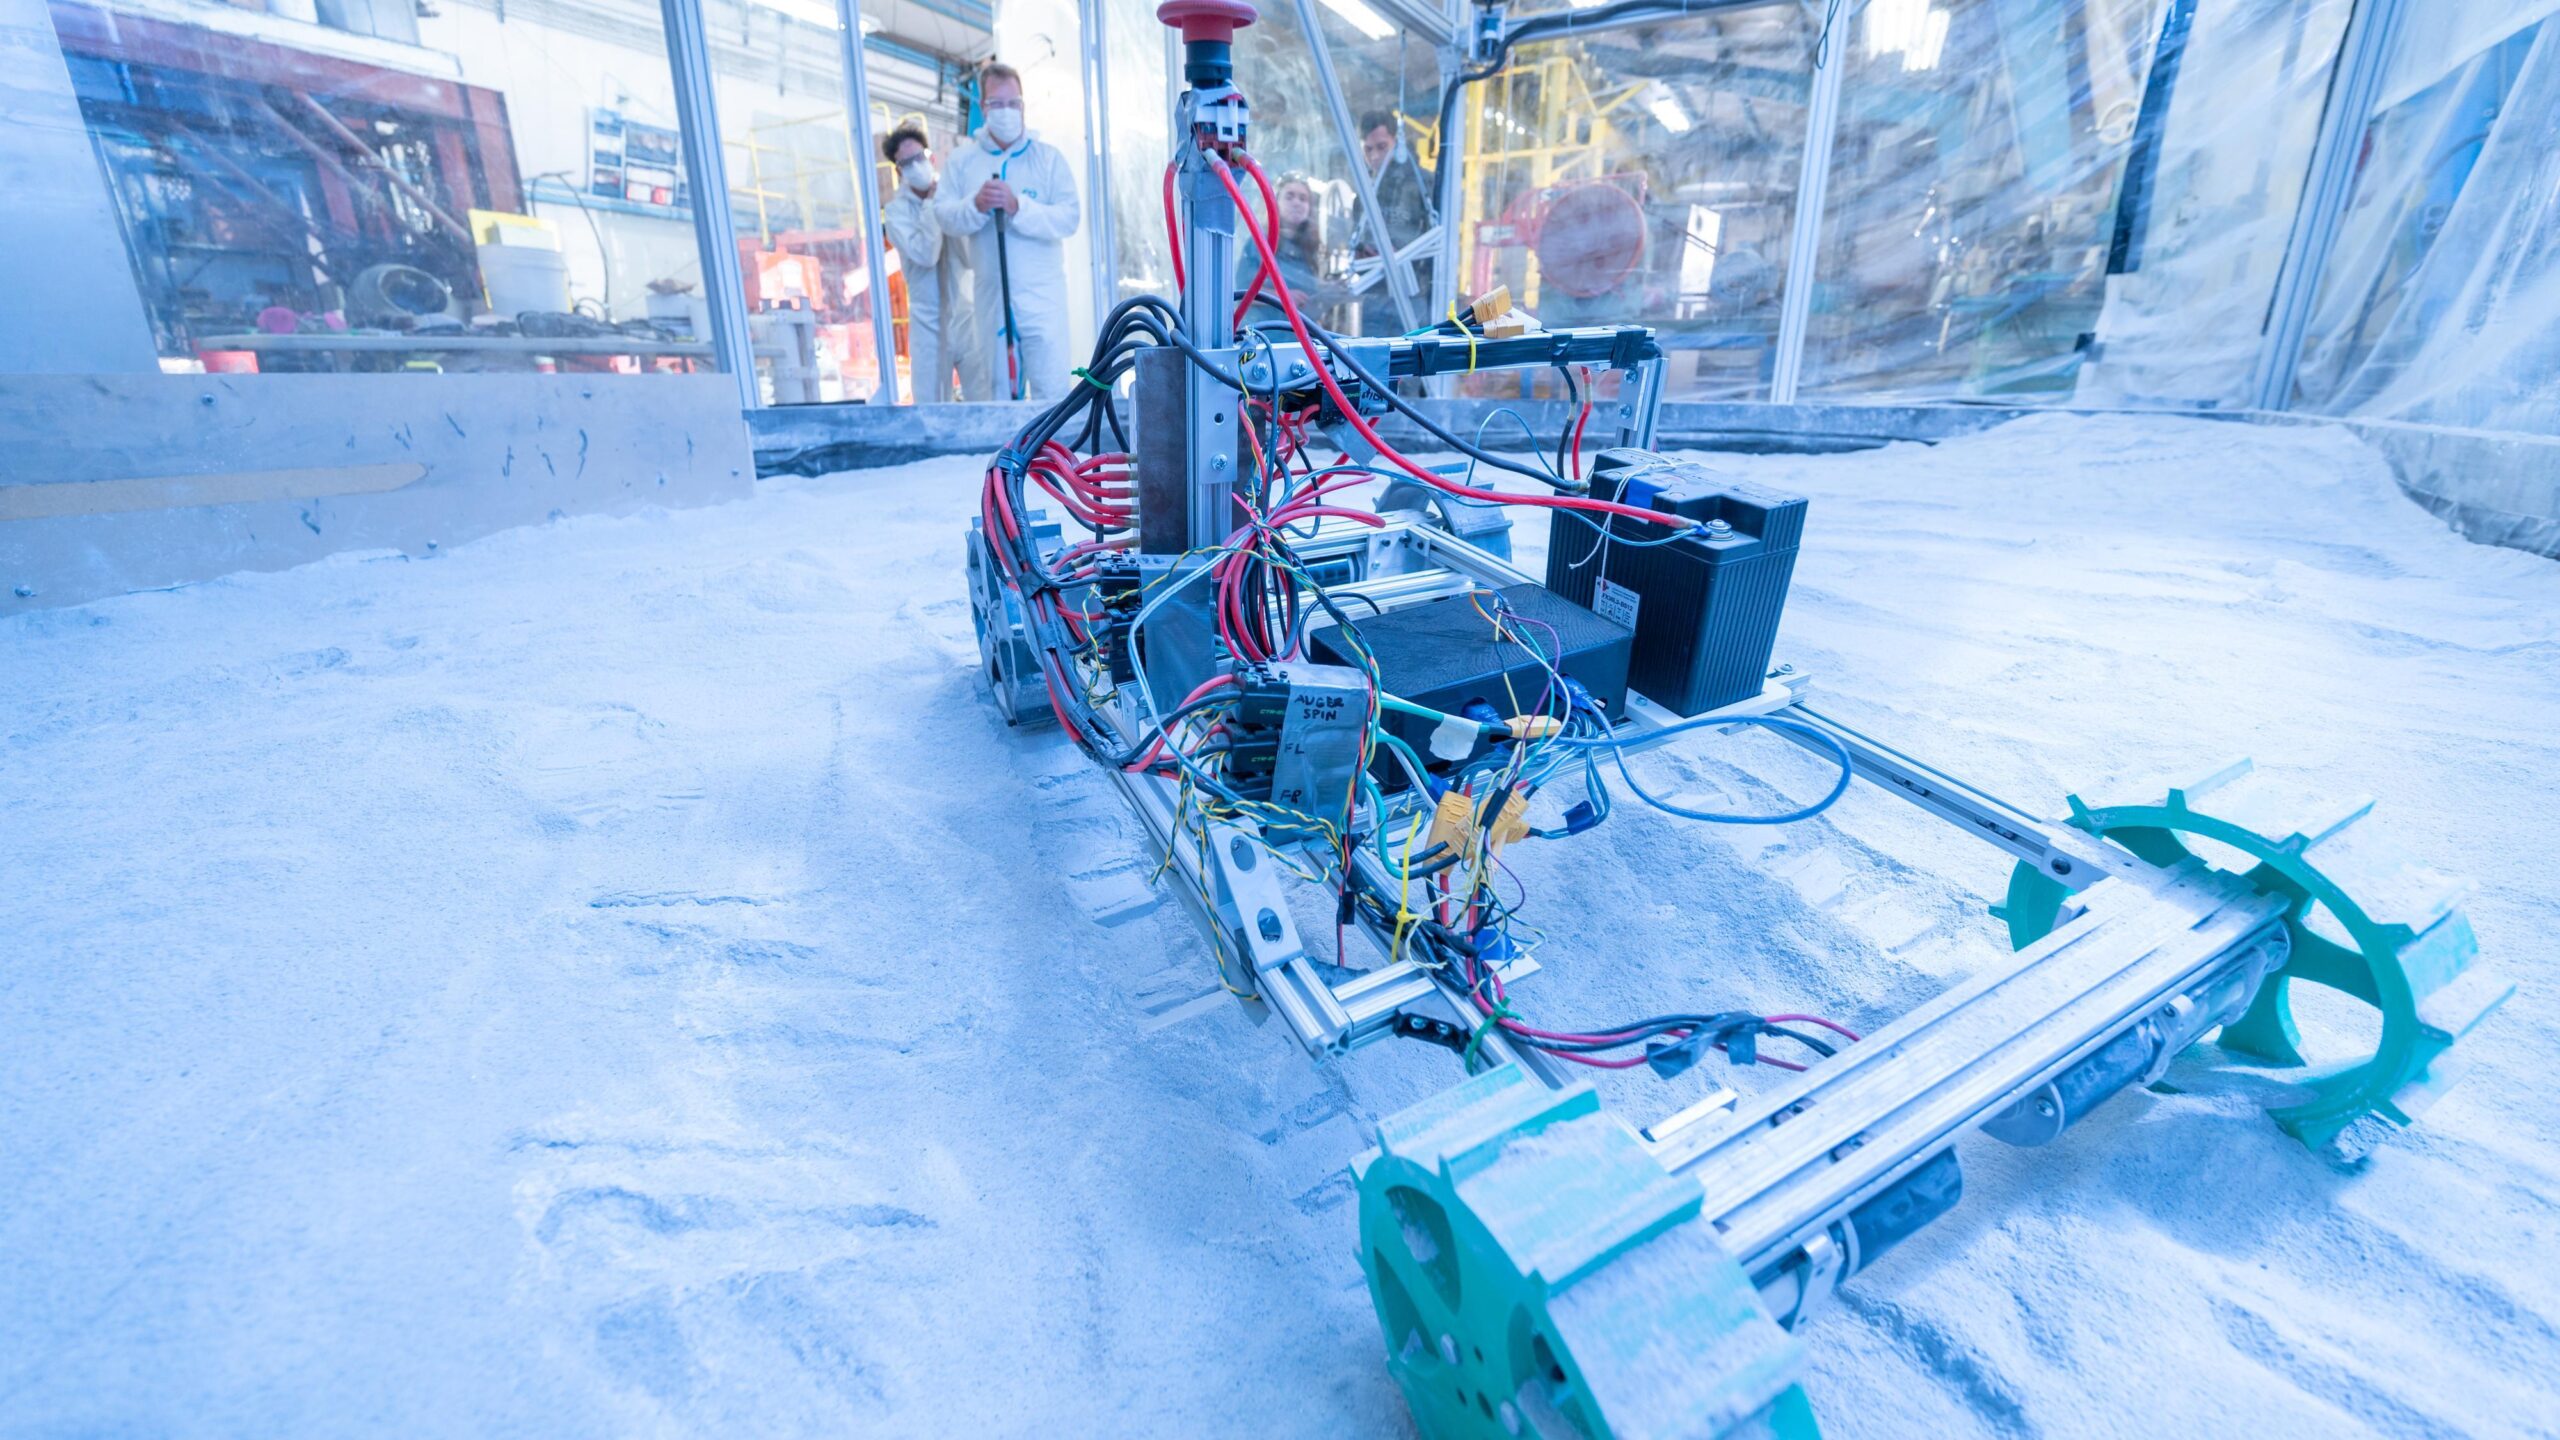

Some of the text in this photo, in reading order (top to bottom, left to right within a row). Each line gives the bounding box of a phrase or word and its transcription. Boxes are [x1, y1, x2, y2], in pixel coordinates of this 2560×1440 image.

[1295, 694, 1344, 708] AUGER
[1303, 709, 1336, 721] SPIN
[1284, 743, 1305, 754] FL
[1281, 789, 1302, 804] FR
